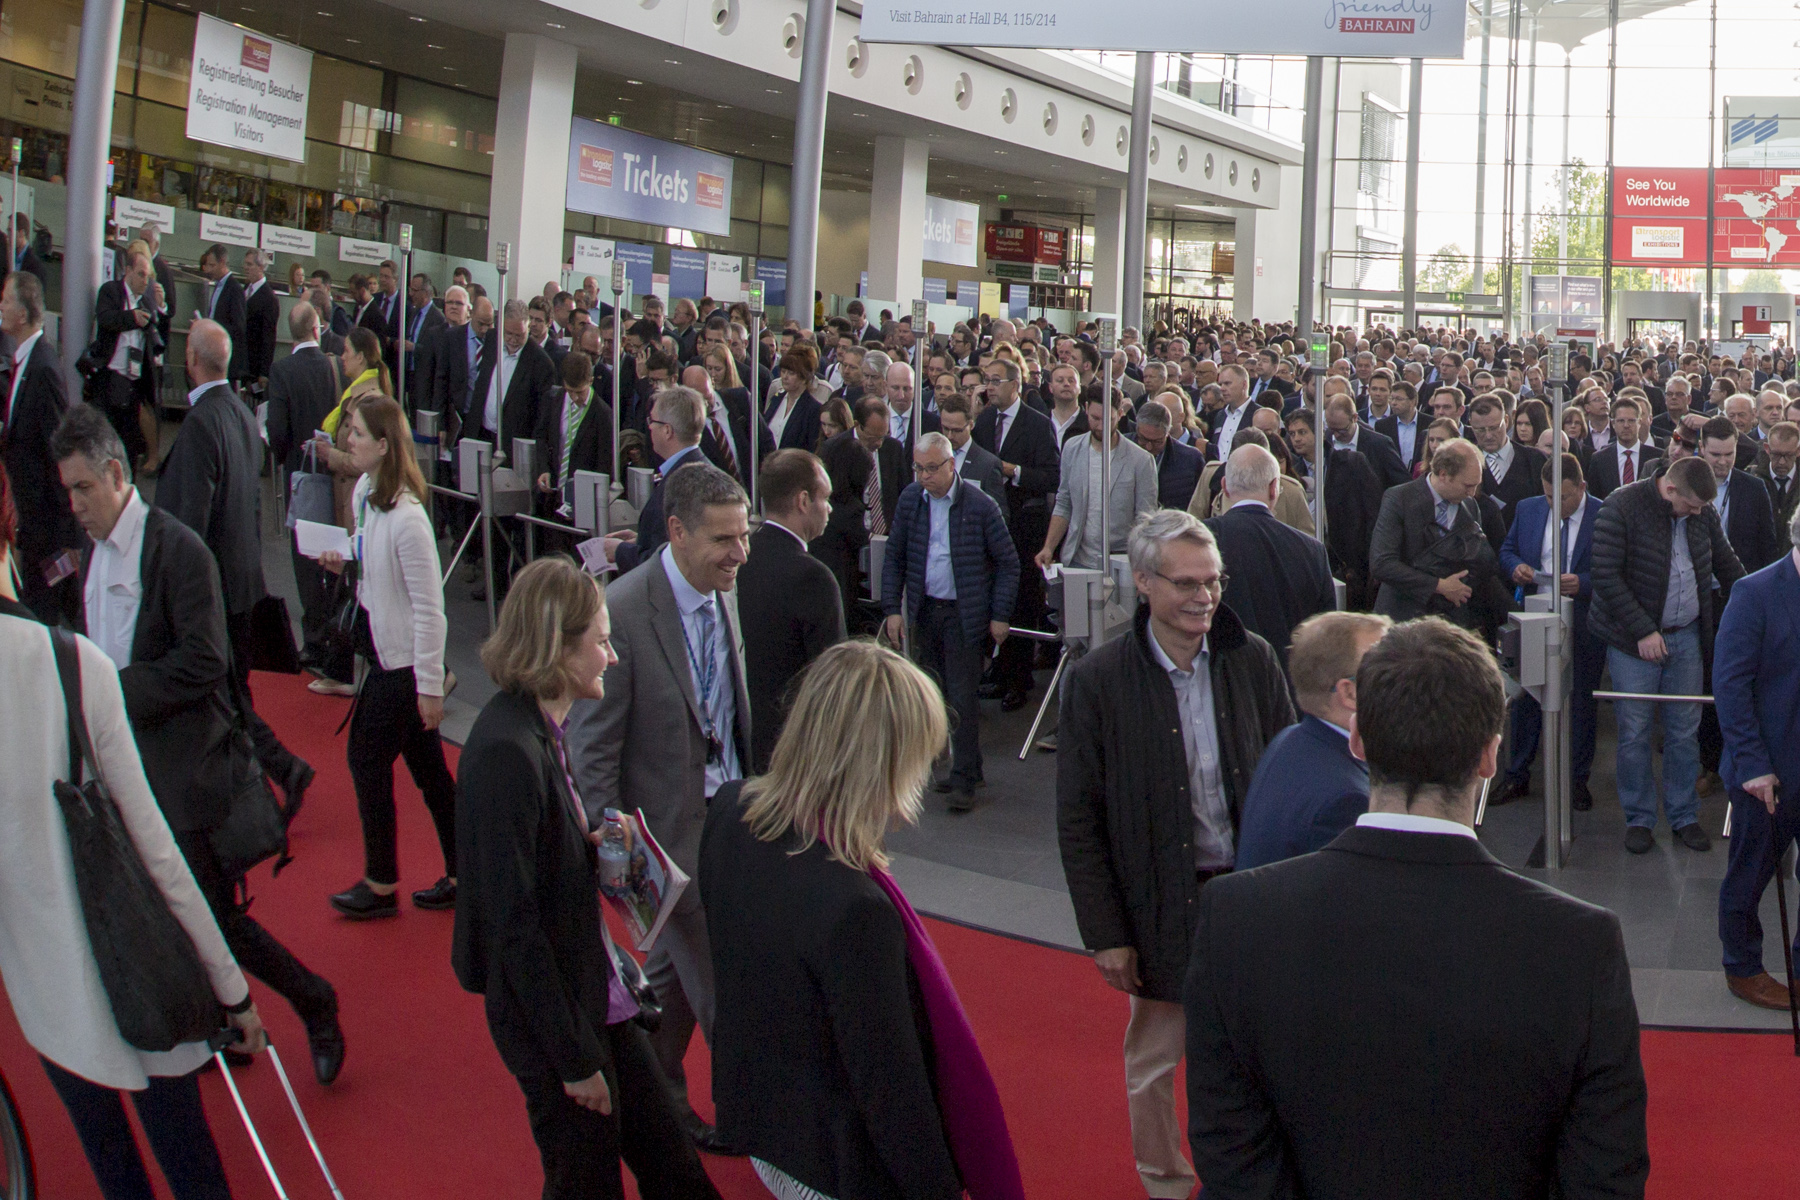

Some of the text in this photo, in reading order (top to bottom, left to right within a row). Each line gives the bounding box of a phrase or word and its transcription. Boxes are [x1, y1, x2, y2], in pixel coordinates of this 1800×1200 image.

[889, 10, 1056, 26] Visit Bahrain at Hall B4, 115/214
[1344, 19, 1413, 34] BAHRAIN
[198, 58, 304, 103] Registrierleitung Besucher
[195, 88, 302, 130] Registration Management
[234, 121, 264, 143] Visitors
[623, 152, 688, 203] Tickets
[1626, 178, 1676, 191] See You
[1626, 194, 1690, 207] Worldwide
[923, 208, 951, 243] ckets
[1642, 228, 1680, 238] transport
[1651, 234, 1680, 242] logistic
